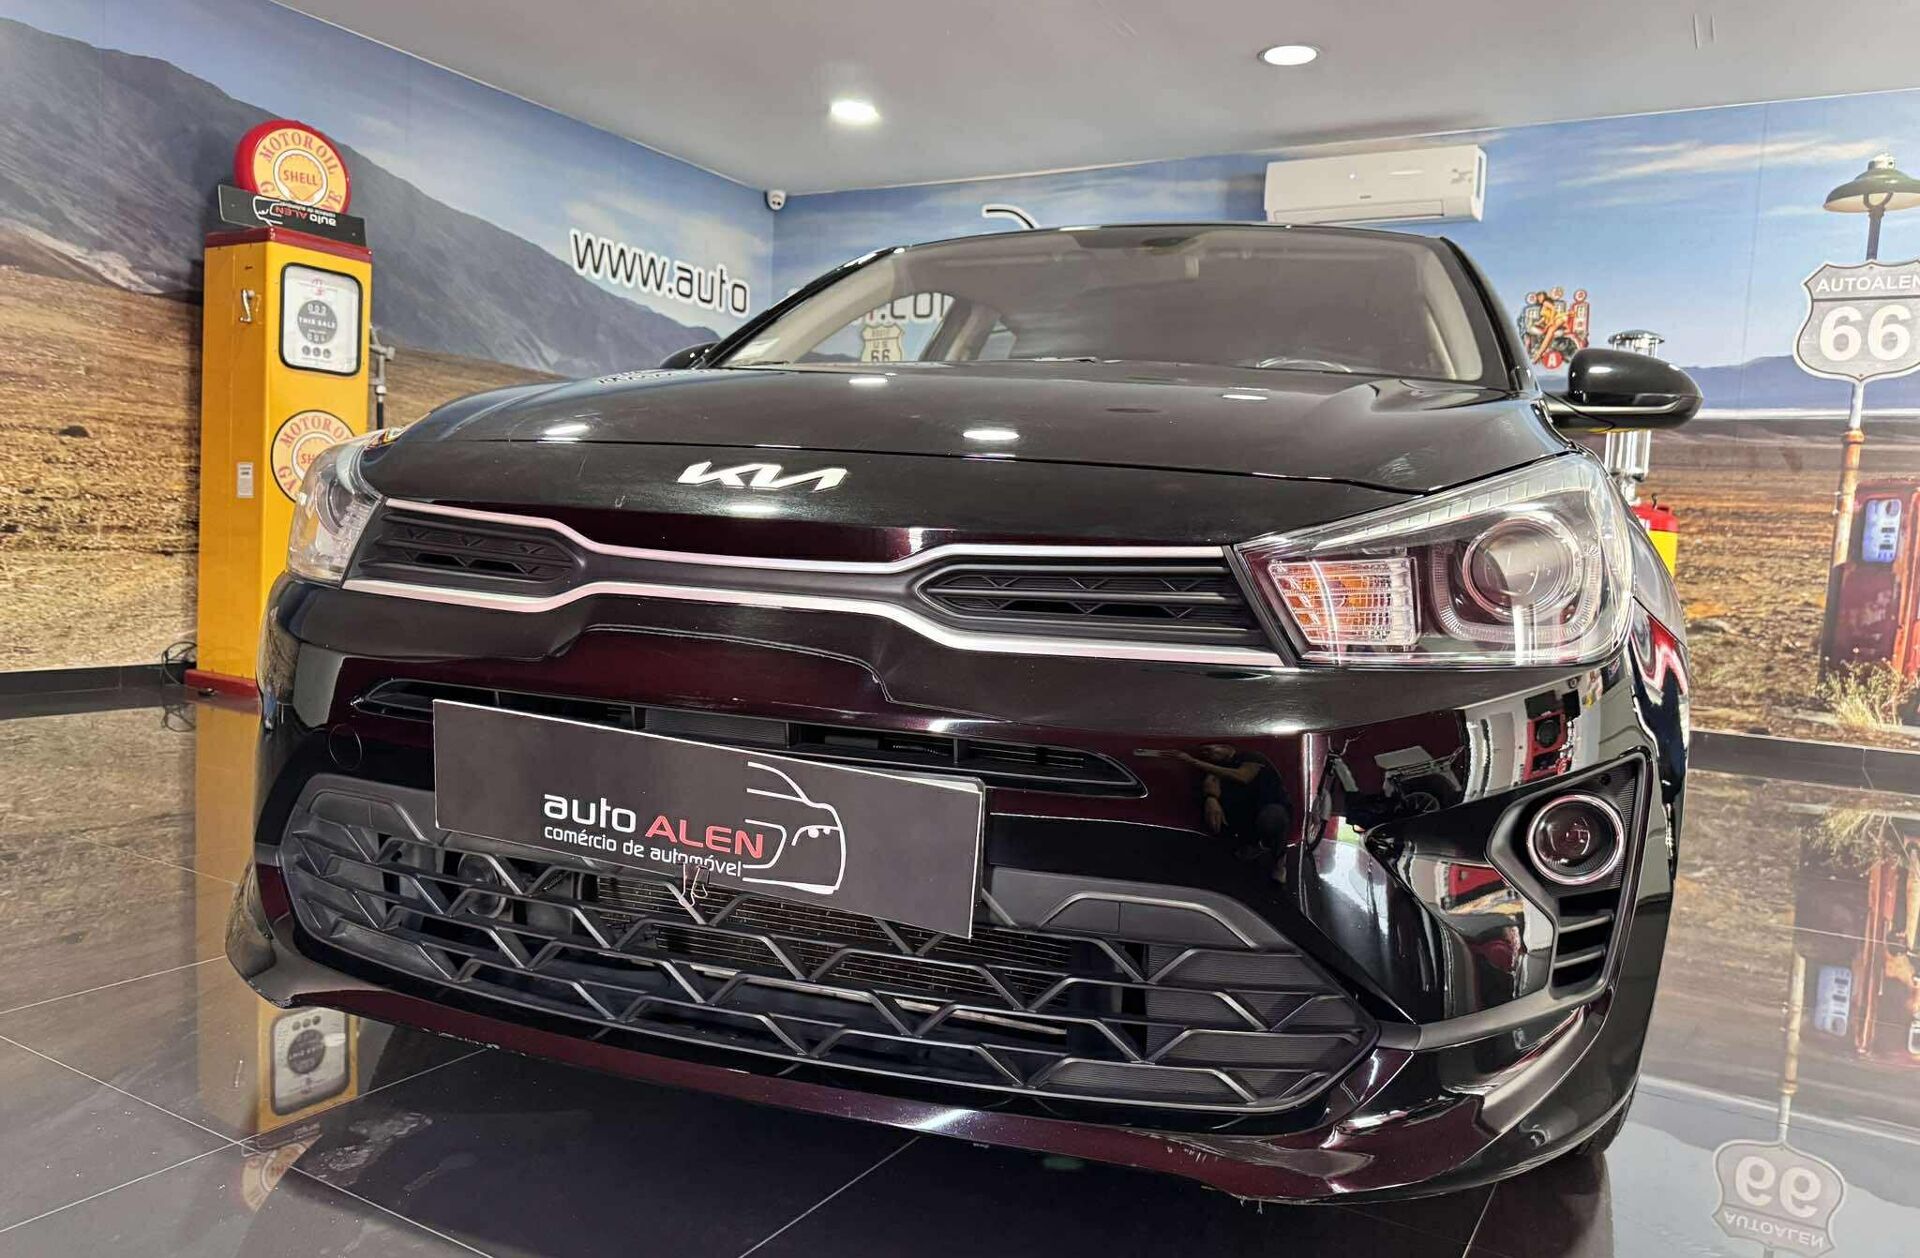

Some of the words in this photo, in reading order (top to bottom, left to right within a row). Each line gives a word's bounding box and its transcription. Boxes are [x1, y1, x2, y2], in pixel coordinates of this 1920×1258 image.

[259, 131, 313, 163] MOTOR
[316, 145, 338, 175] OIL
[283, 170, 318, 187] SHELL
[275, 205, 308, 219] ALEN
[1816, 275, 1920, 293] AUTOALEN
[1820, 304, 1911, 361] 66
[280, 415, 332, 448] MOTOR
[543, 793, 637, 834] auto
[645, 815, 763, 859] ALEN
[544, 825, 617, 852] comércio
[622, 839, 645, 858] de
